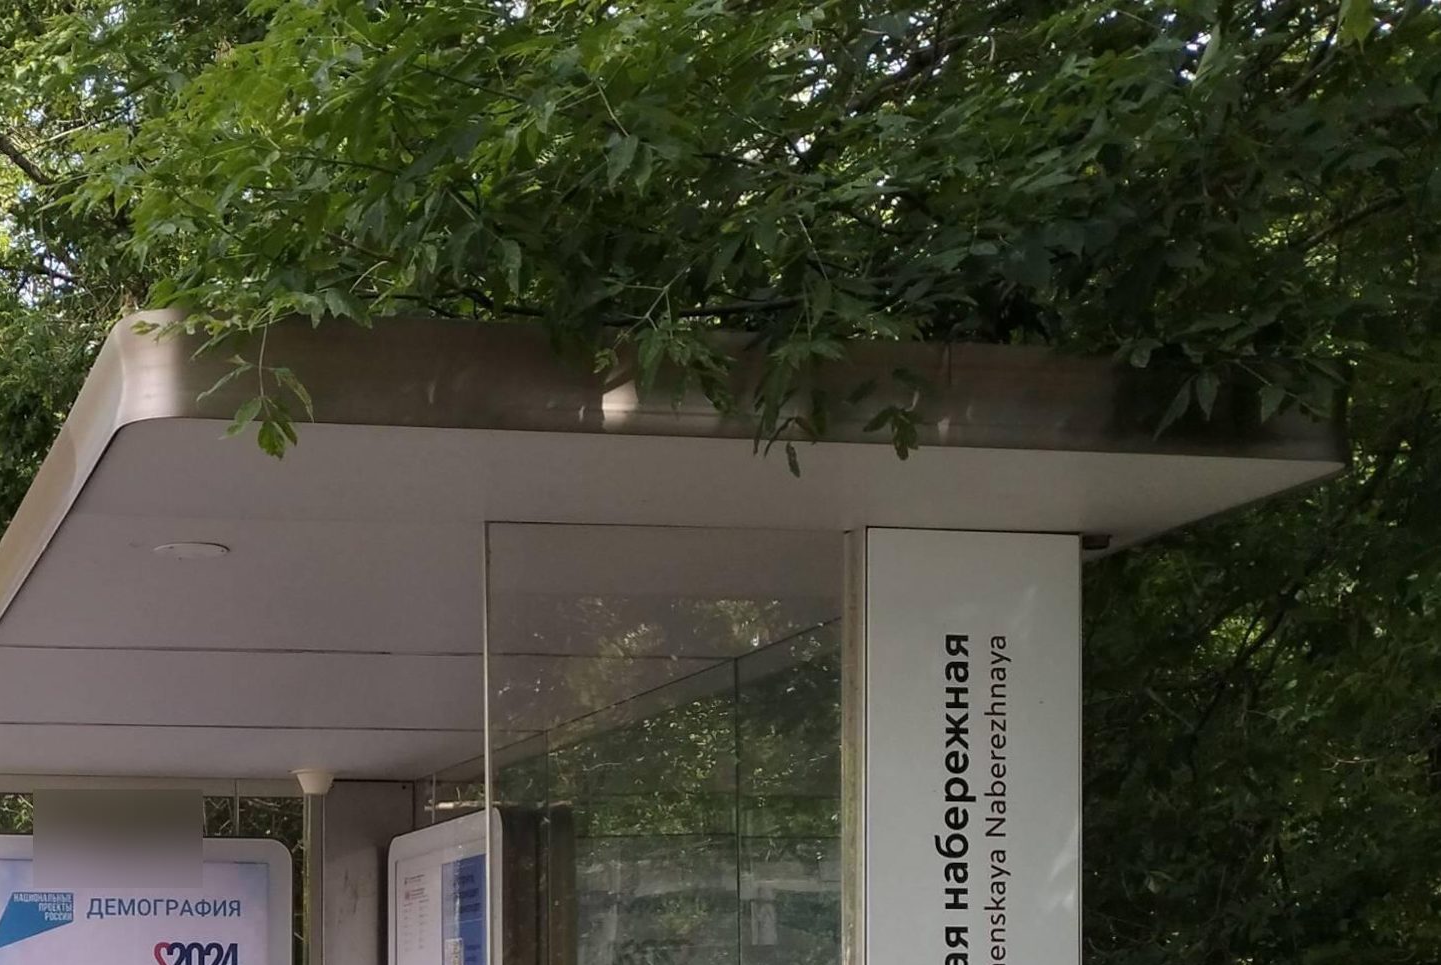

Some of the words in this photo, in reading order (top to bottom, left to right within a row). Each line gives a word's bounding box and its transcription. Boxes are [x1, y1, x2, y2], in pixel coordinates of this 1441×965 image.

[934, 634, 976, 911] набережная
[985, 634, 1012, 838] Naberezhnaya
[86, 898, 241, 919] ДЕМОГРАФИЯ
